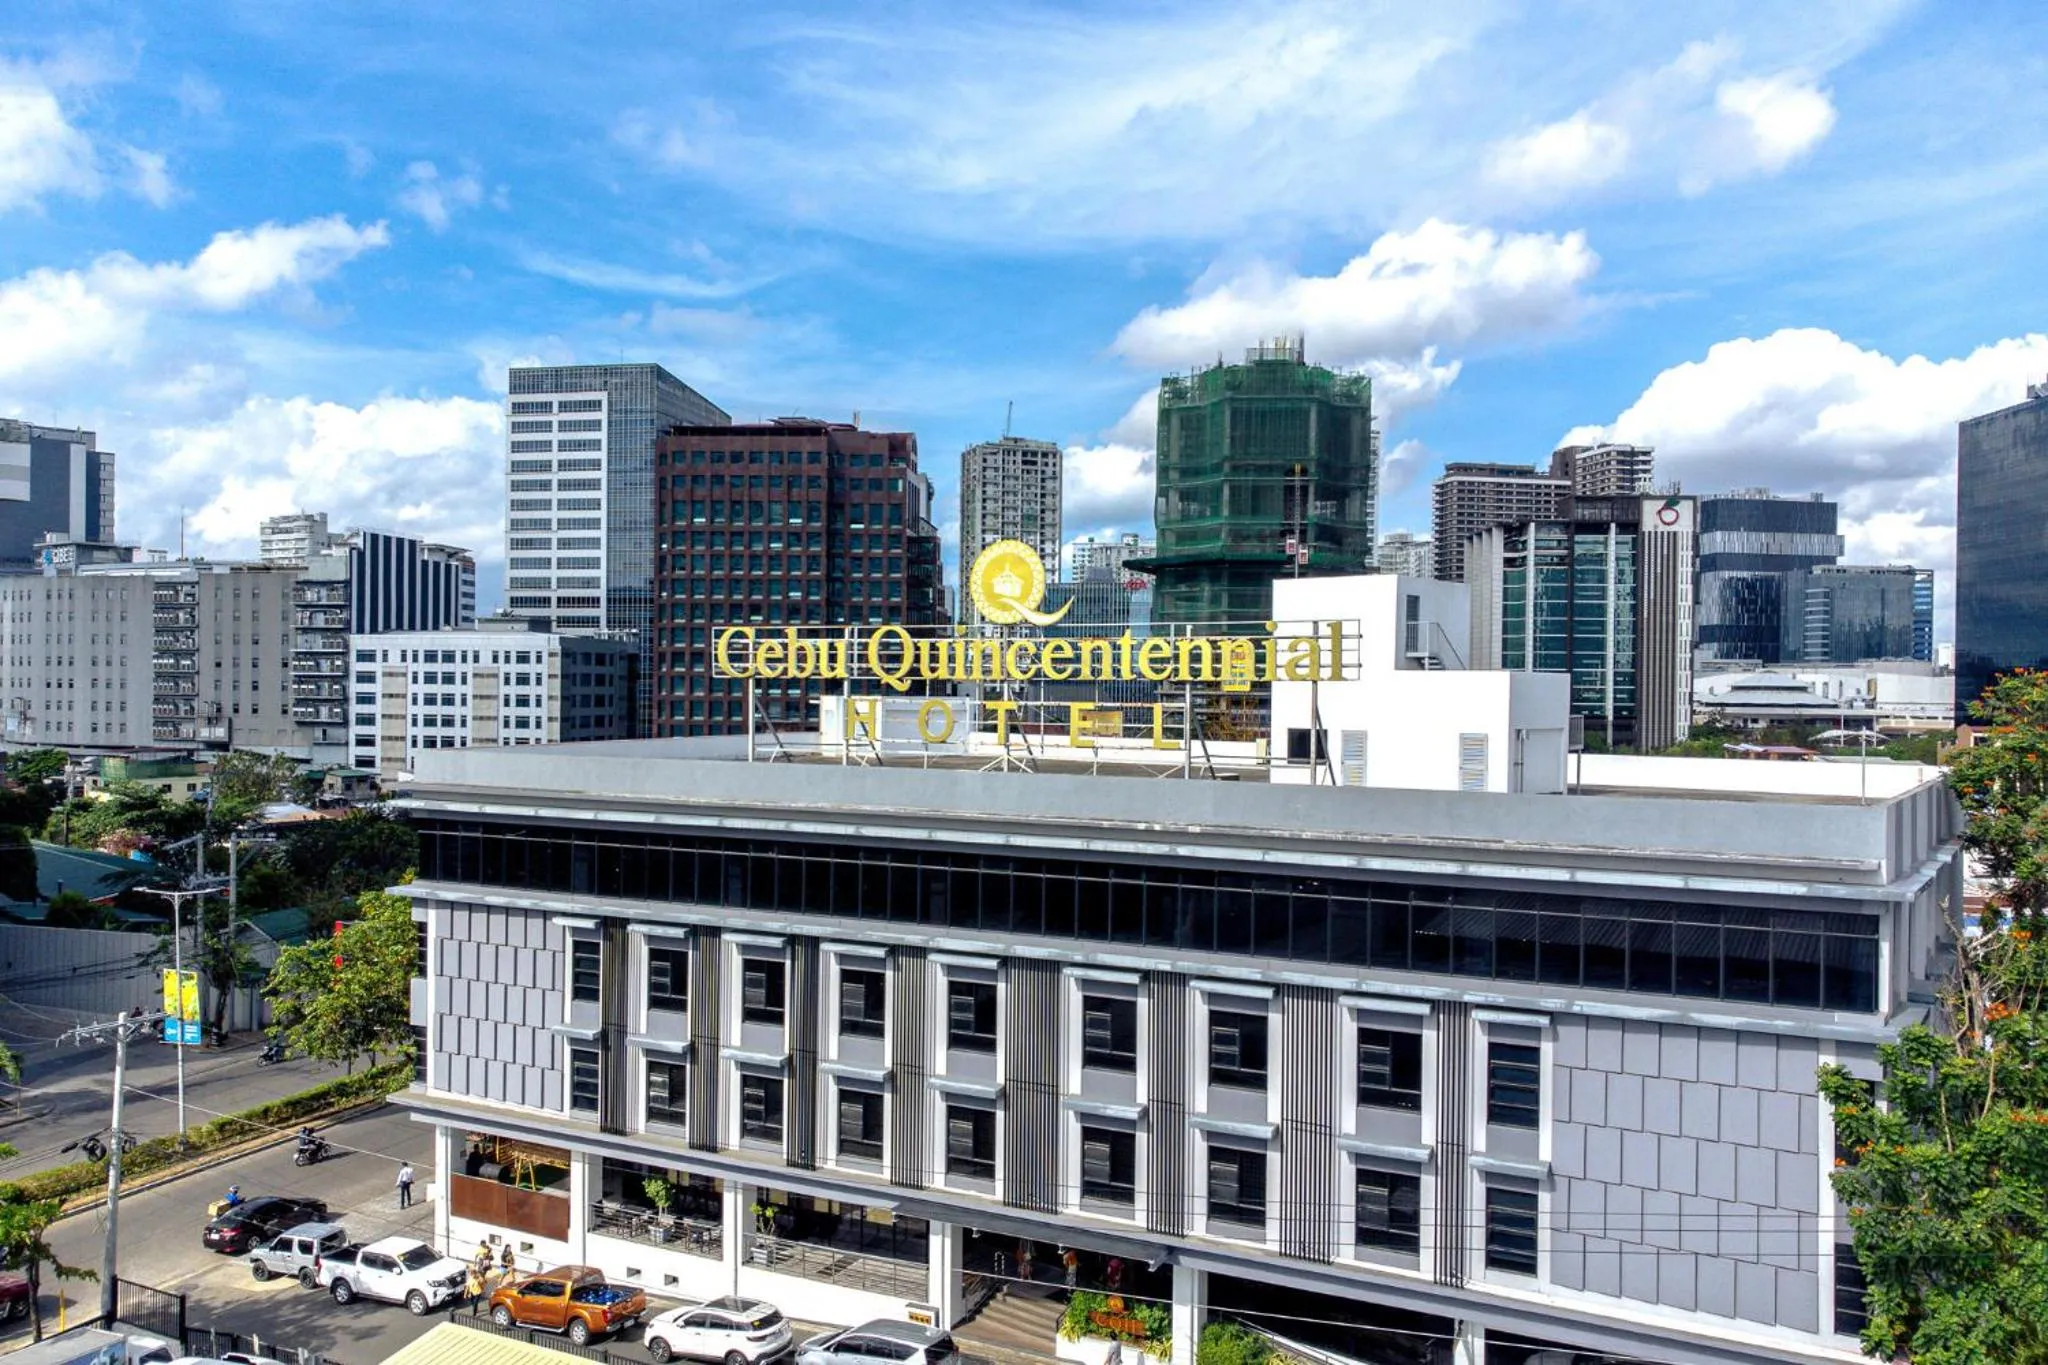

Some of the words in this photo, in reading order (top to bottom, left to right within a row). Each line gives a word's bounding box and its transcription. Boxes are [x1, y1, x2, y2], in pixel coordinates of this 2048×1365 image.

[717, 626, 849, 679] Cebu
[867, 620, 1343, 692] Quincentennial
[845, 699, 1181, 749] HOTEL
